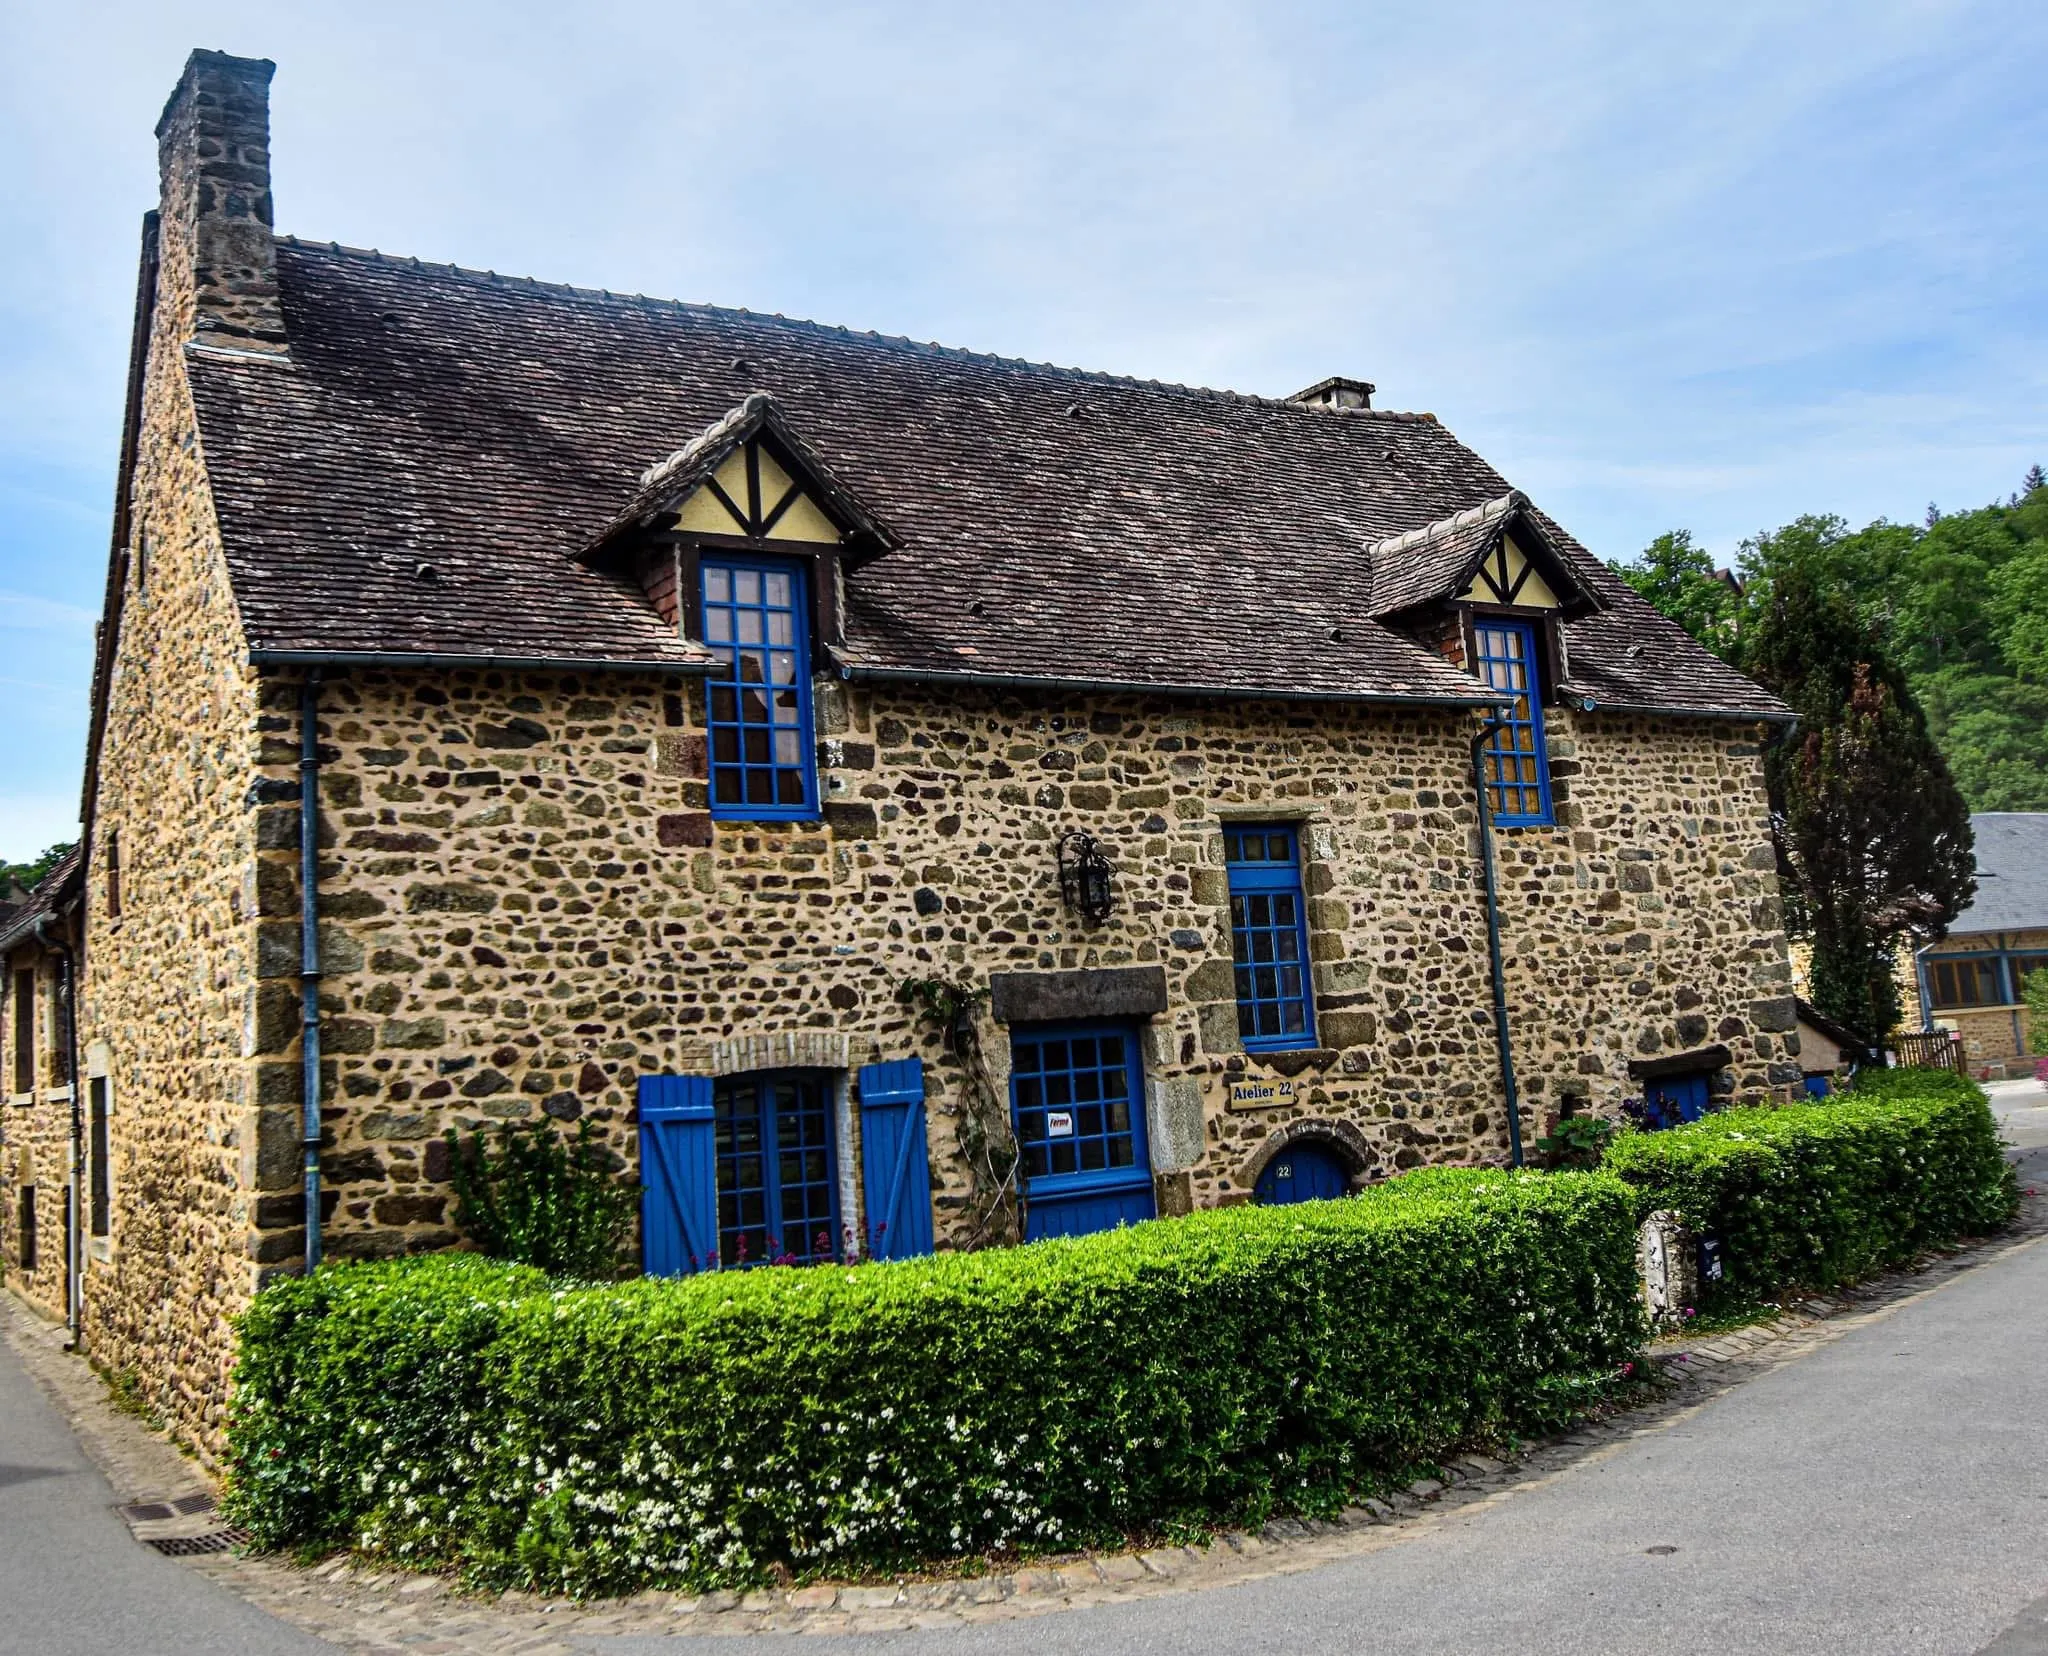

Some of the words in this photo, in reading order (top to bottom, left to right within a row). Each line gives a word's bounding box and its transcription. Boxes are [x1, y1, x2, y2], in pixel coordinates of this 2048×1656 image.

[1234, 1085, 1274, 1100] Atelier
[1279, 1082, 1292, 1095] 22
[1278, 1166, 1289, 1177] 22
